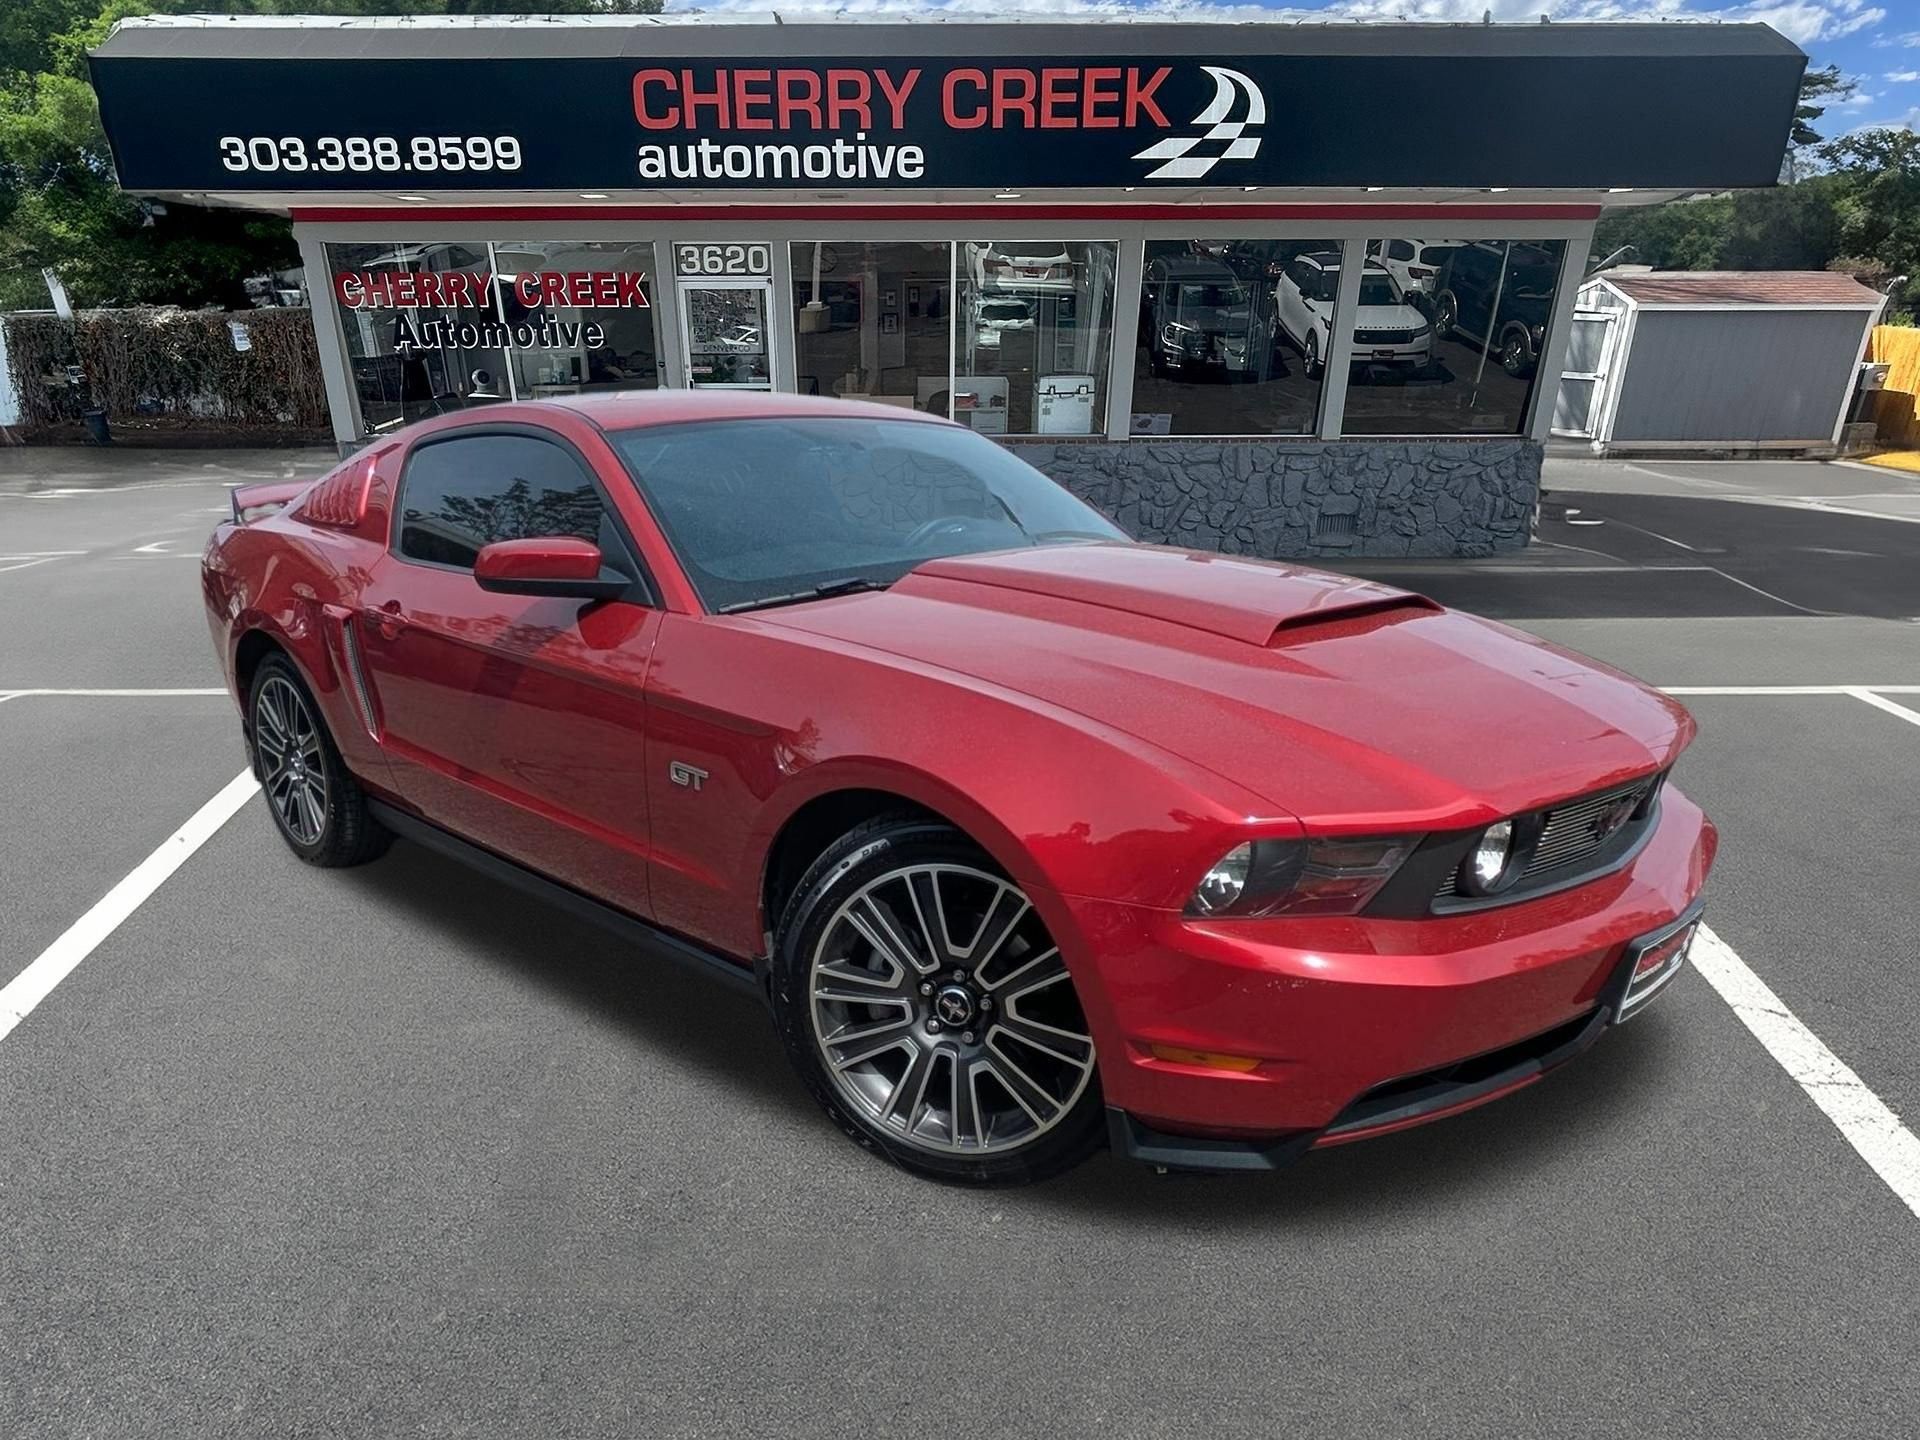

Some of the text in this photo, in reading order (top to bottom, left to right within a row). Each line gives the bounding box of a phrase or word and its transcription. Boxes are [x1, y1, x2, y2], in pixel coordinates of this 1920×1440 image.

[633, 66, 1172, 131] CHERRY CREEK
[219, 136, 522, 172] 303.388.8599
[638, 132, 925, 180] automotive
[680, 245, 769, 274] 3620
[334, 272, 650, 308] CHERRY CREEK
[393, 313, 606, 350] Automotive
[670, 760, 709, 791] GT
